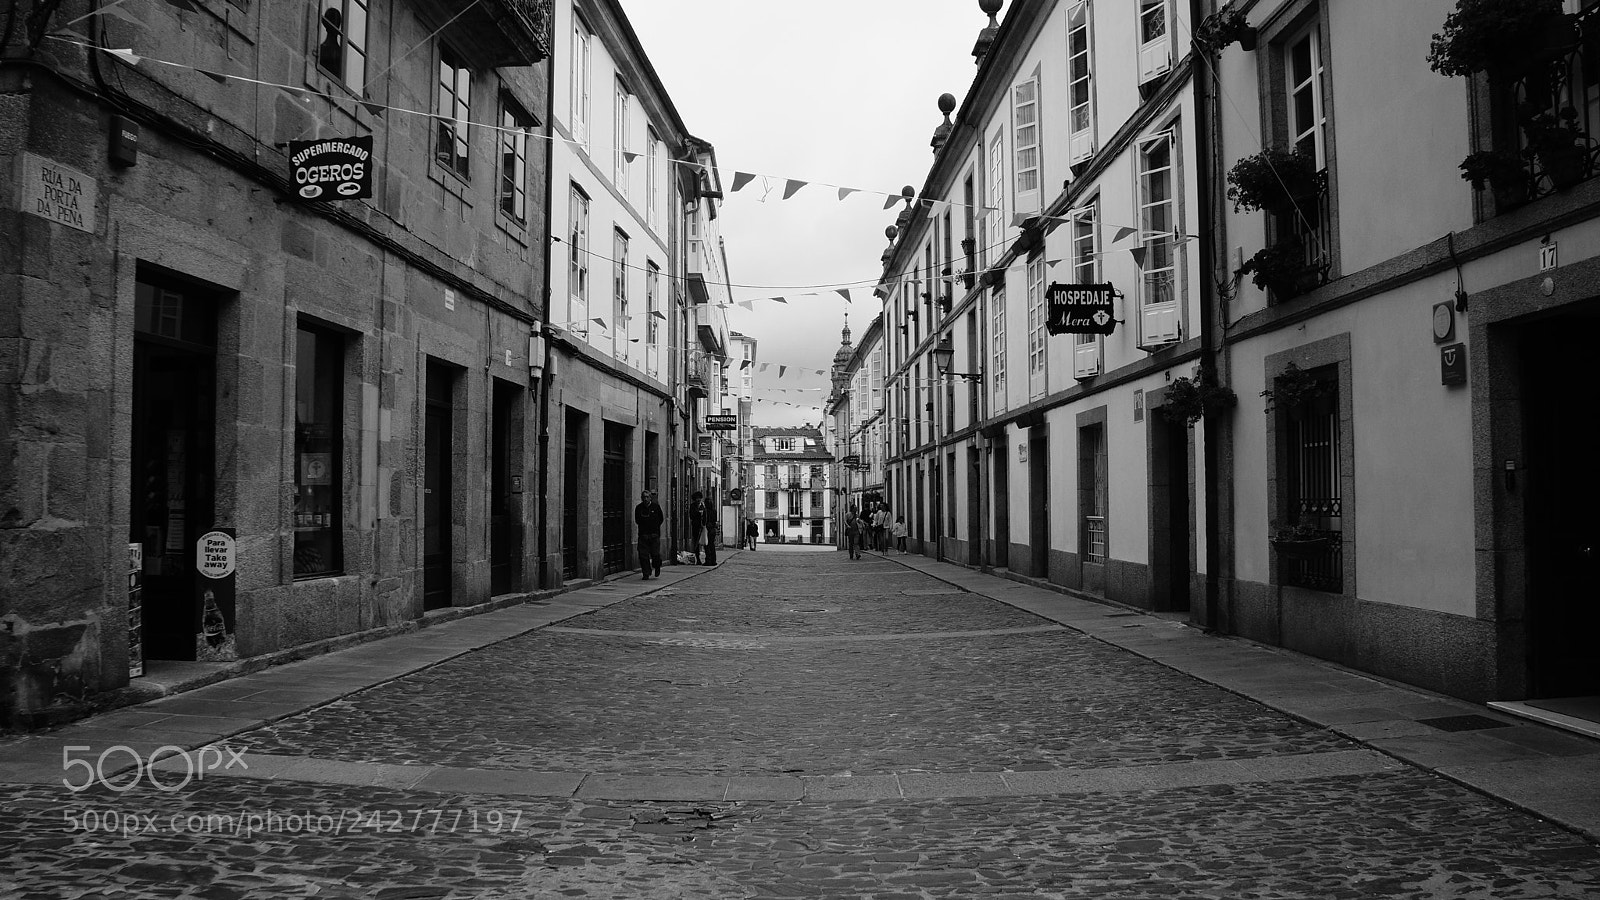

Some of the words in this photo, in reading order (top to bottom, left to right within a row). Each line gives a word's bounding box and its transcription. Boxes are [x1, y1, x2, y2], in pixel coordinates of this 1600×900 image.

[292, 142, 369, 166] SUPERMERCADO
[296, 162, 364, 184] OGEROS
[69, 177, 82, 195] DA
[45, 184, 78, 209] PORTA
[37, 198, 51, 216] DA
[1542, 247, 1556, 268] 17
[1053, 290, 1110, 305] HOSPEDAJE
[1055, 311, 1091, 326] Mera
